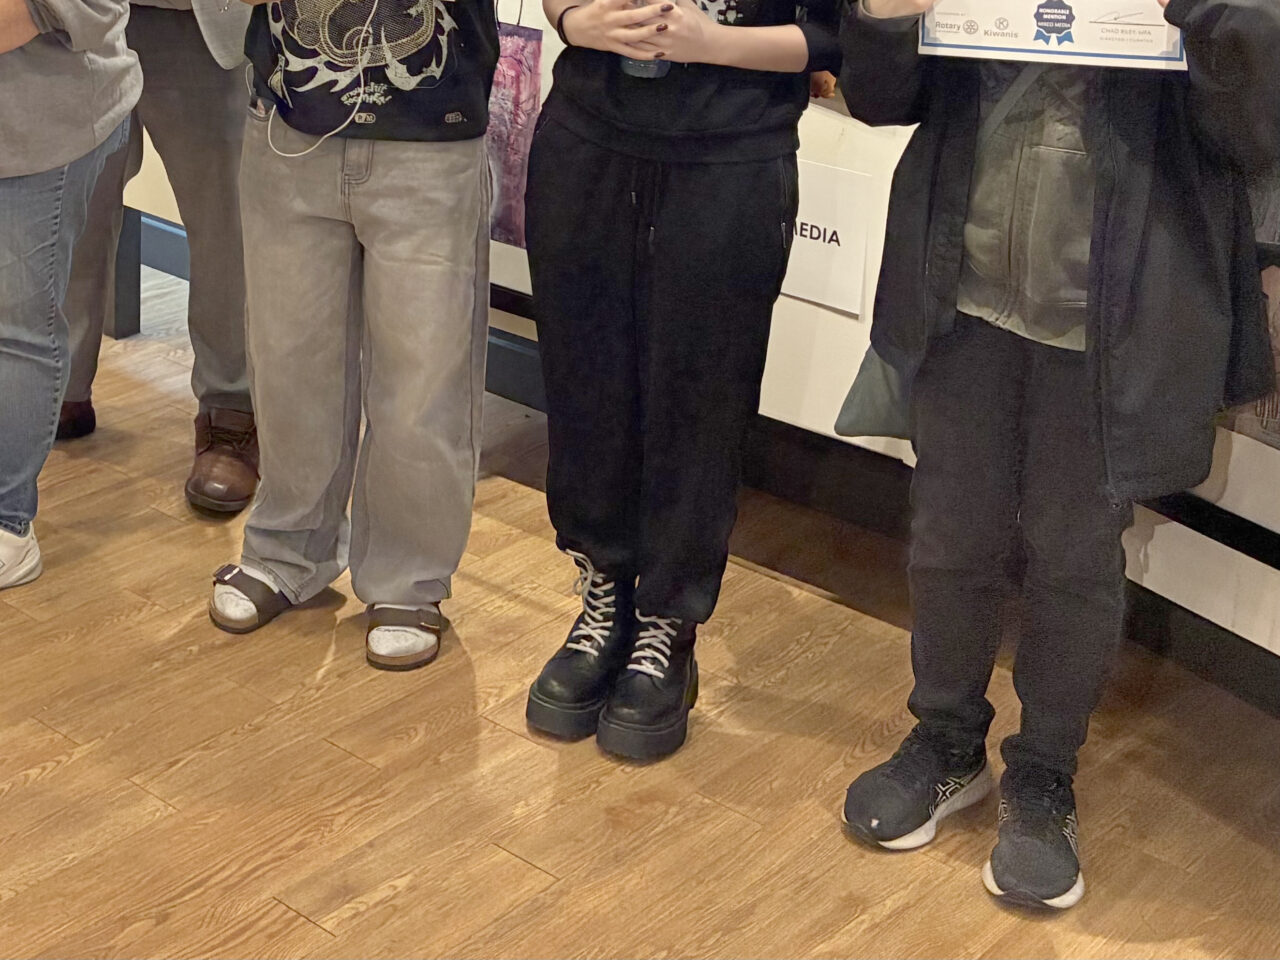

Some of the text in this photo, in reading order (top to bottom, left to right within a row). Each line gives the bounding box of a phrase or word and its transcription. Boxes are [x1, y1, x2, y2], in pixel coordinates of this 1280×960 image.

[935, 21, 961, 31] Rotary
[983, 29, 1019, 38] Kiwanis
[794, 219, 841, 247] EDIA
